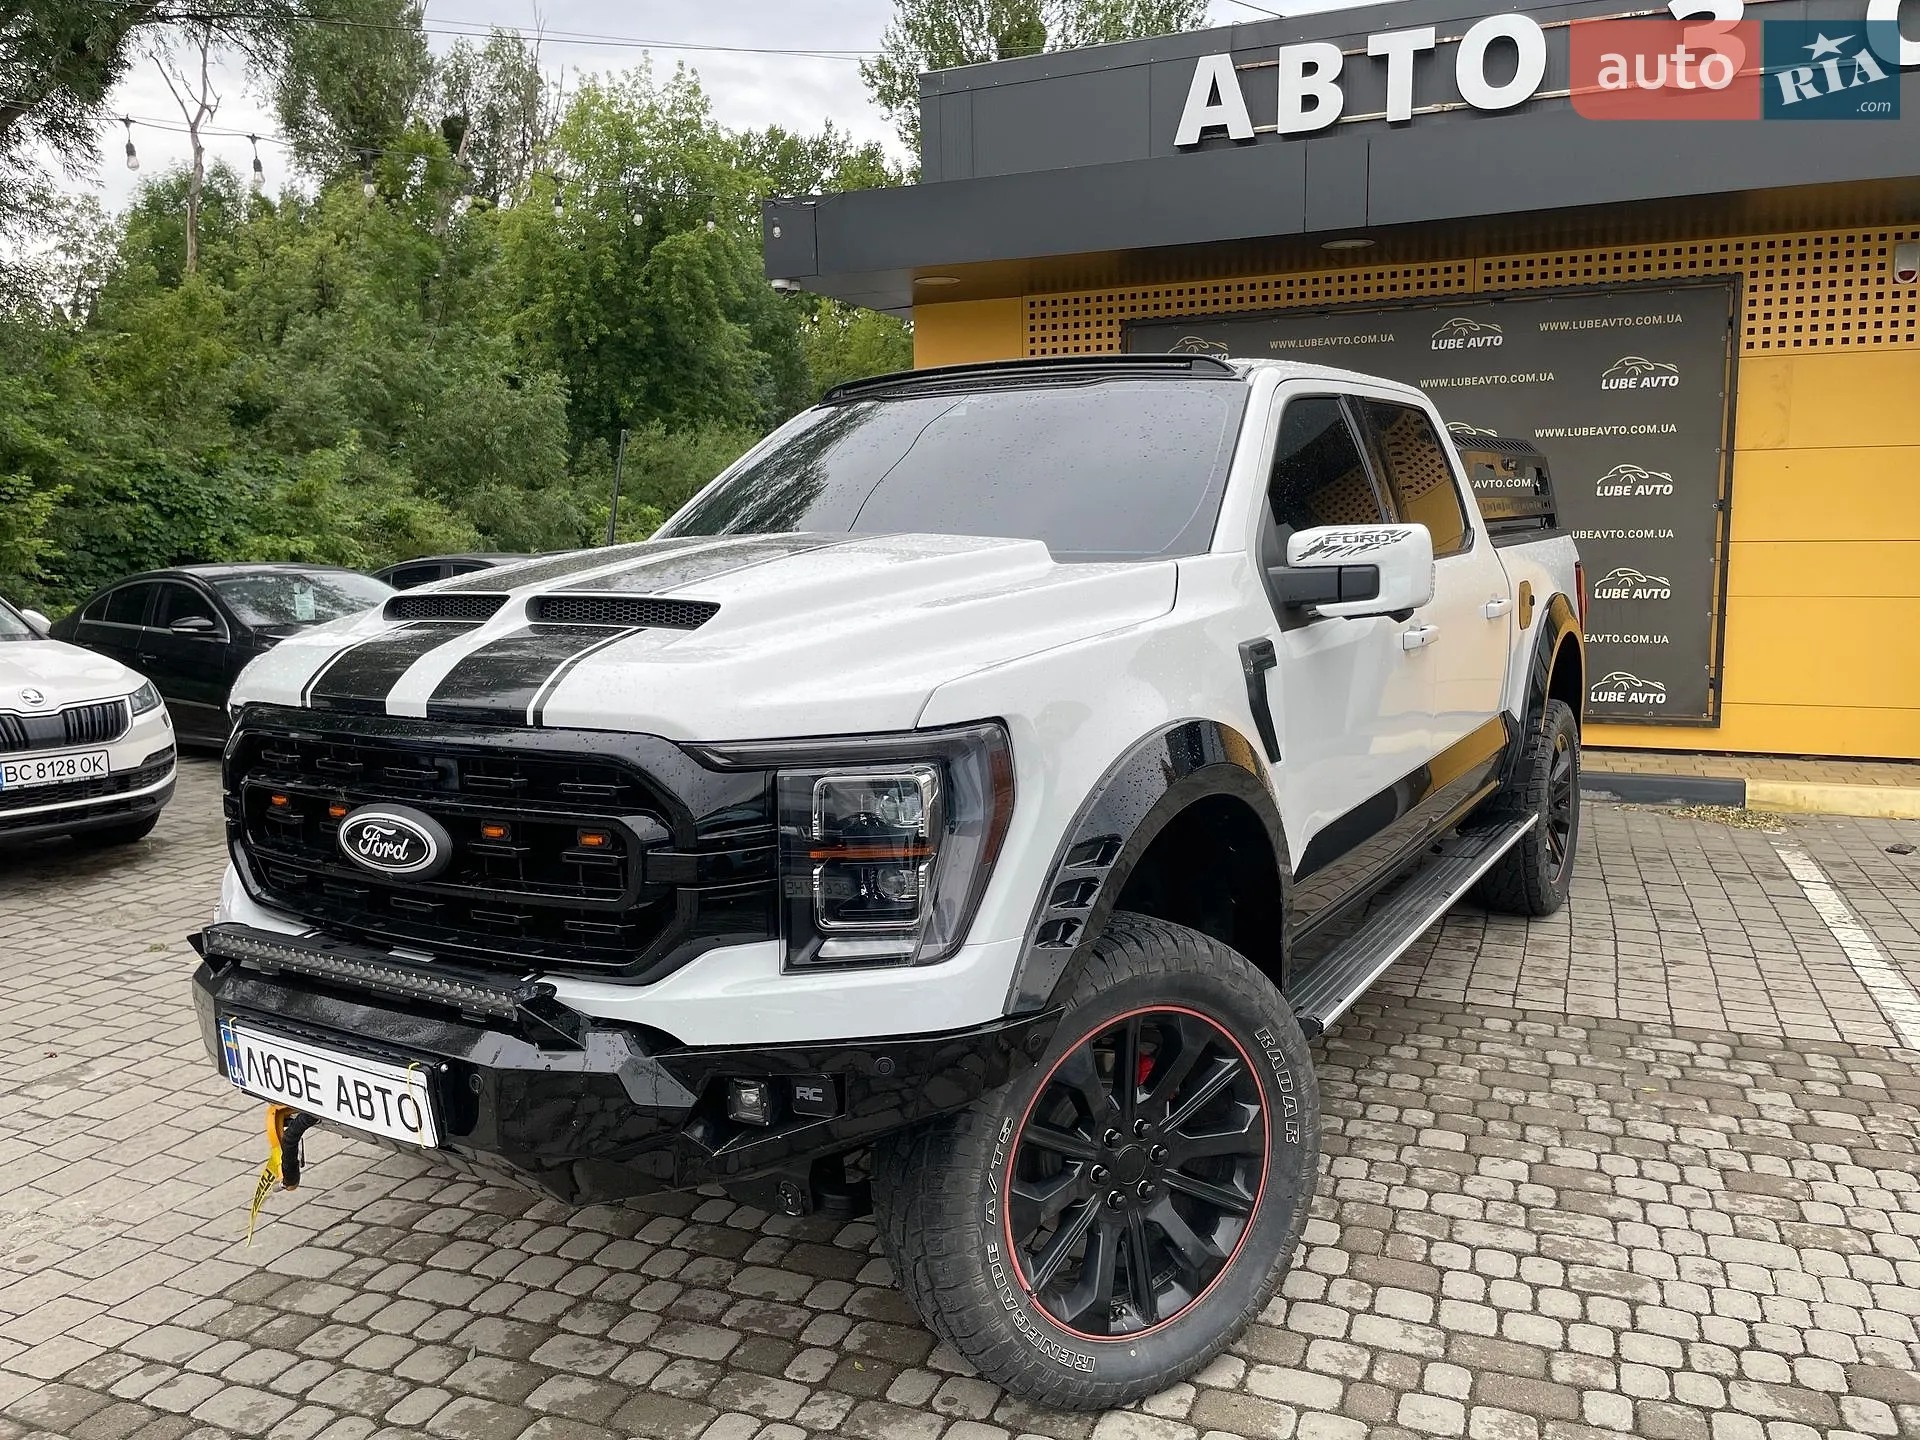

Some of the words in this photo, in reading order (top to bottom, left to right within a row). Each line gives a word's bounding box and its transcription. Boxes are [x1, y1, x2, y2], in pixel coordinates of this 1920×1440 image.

[1173, 14, 1547, 148] АВТО
[1539, 314, 1683, 331] WWW.LUBEAVTO.COM.UA
[1269, 333, 1395, 350] WWW.LUBEAVTO.COM.UA
[1431, 338, 1464, 350] LUBE
[1467, 335, 1503, 348] AVTO
[1420, 372, 1554, 388] WWW.LUBEAVTO.COM.UA
[1601, 377, 1636, 390] LUBE
[1640, 375, 1679, 388] AVTO
[1535, 424, 1677, 438] WWW.LUBEAVTO.COM.UA
[1596, 485, 1631, 497] LUBE
[1635, 484, 1673, 496] AVTO
[1325, 533, 1390, 545] FORD
[1594, 588, 1629, 599] LUBE
[1632, 588, 1671, 600] AVTO
[1590, 691, 1625, 703] LUBE
[1628, 693, 1666, 704] AVTO
[4, 764, 32, 783] BC
[36, 759, 76, 779] 8128
[80, 755, 104, 773] OK
[358, 824, 409, 861] Ford
[247, 1046, 323, 1106] ЛЮБЕ
[336, 1074, 424, 1134] АВТО
[1254, 1027, 1300, 1144] RADAR
[795, 1086, 823, 1102] RC
[986, 1242, 1096, 1373] RENEGADE
